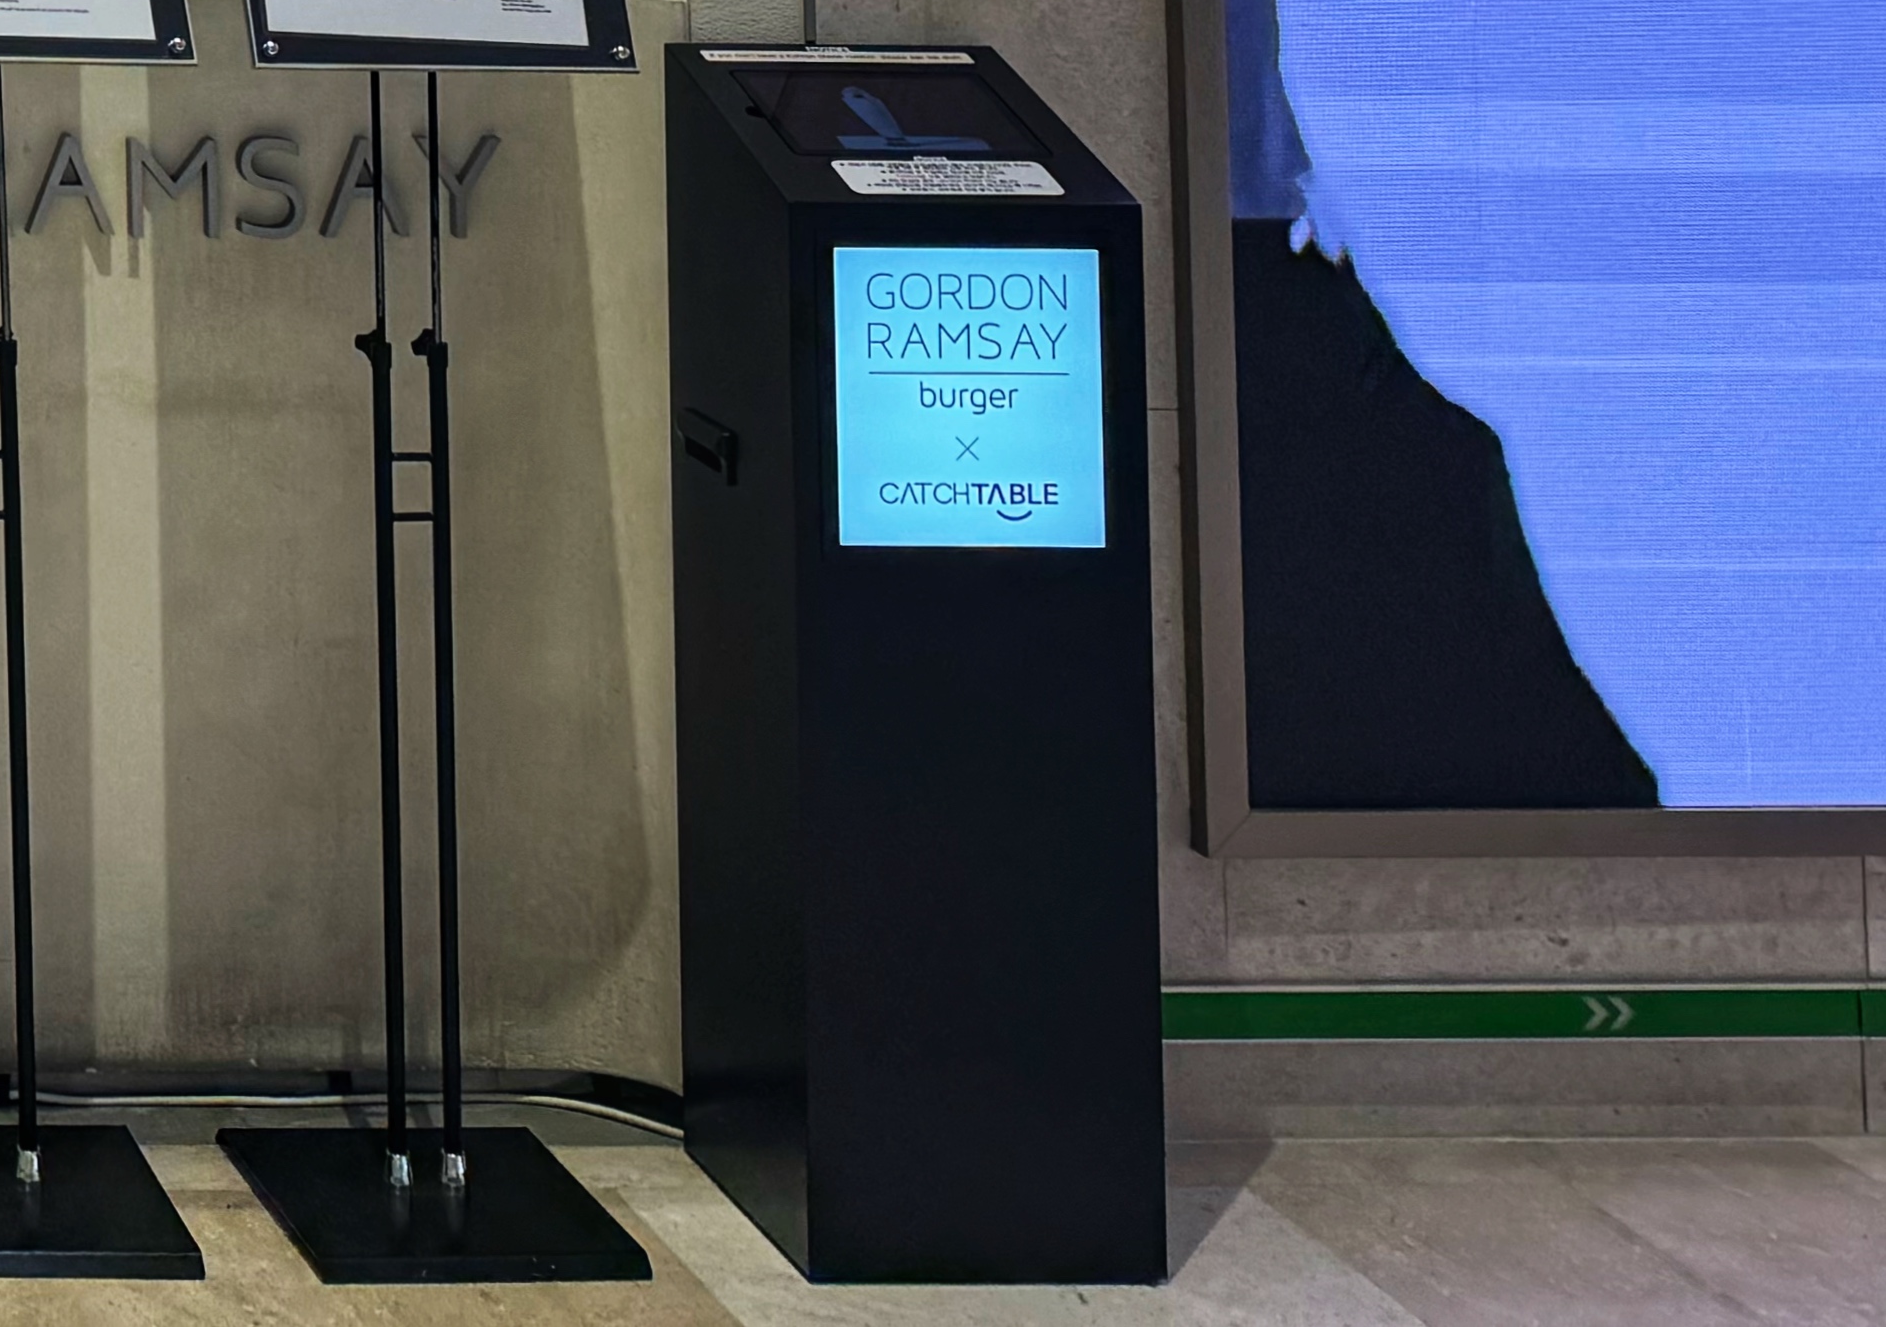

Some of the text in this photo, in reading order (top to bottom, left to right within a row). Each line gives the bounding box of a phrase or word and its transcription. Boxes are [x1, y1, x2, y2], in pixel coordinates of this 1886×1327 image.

[866, 272, 1068, 311] GORDON
[867, 322, 1068, 360] RAMSAY
[918, 380, 1019, 415] burger
[879, 482, 1060, 506] CATCHTABLE
